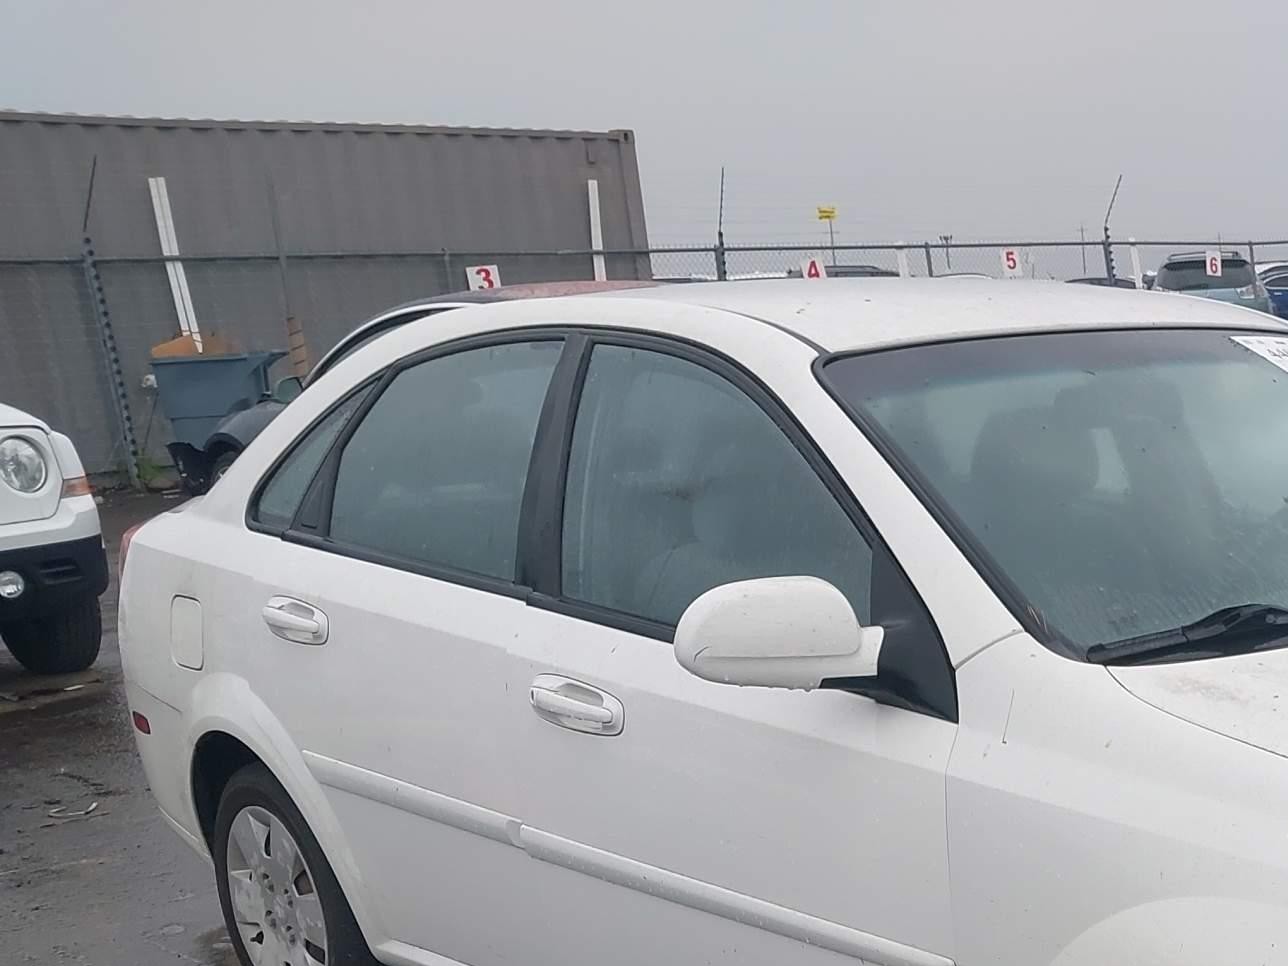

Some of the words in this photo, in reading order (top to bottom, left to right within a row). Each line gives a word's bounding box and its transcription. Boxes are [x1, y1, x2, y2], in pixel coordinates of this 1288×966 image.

[1006, 251, 1017, 270] 5
[1210, 256, 1218, 274] 6
[475, 268, 494, 289] 3
